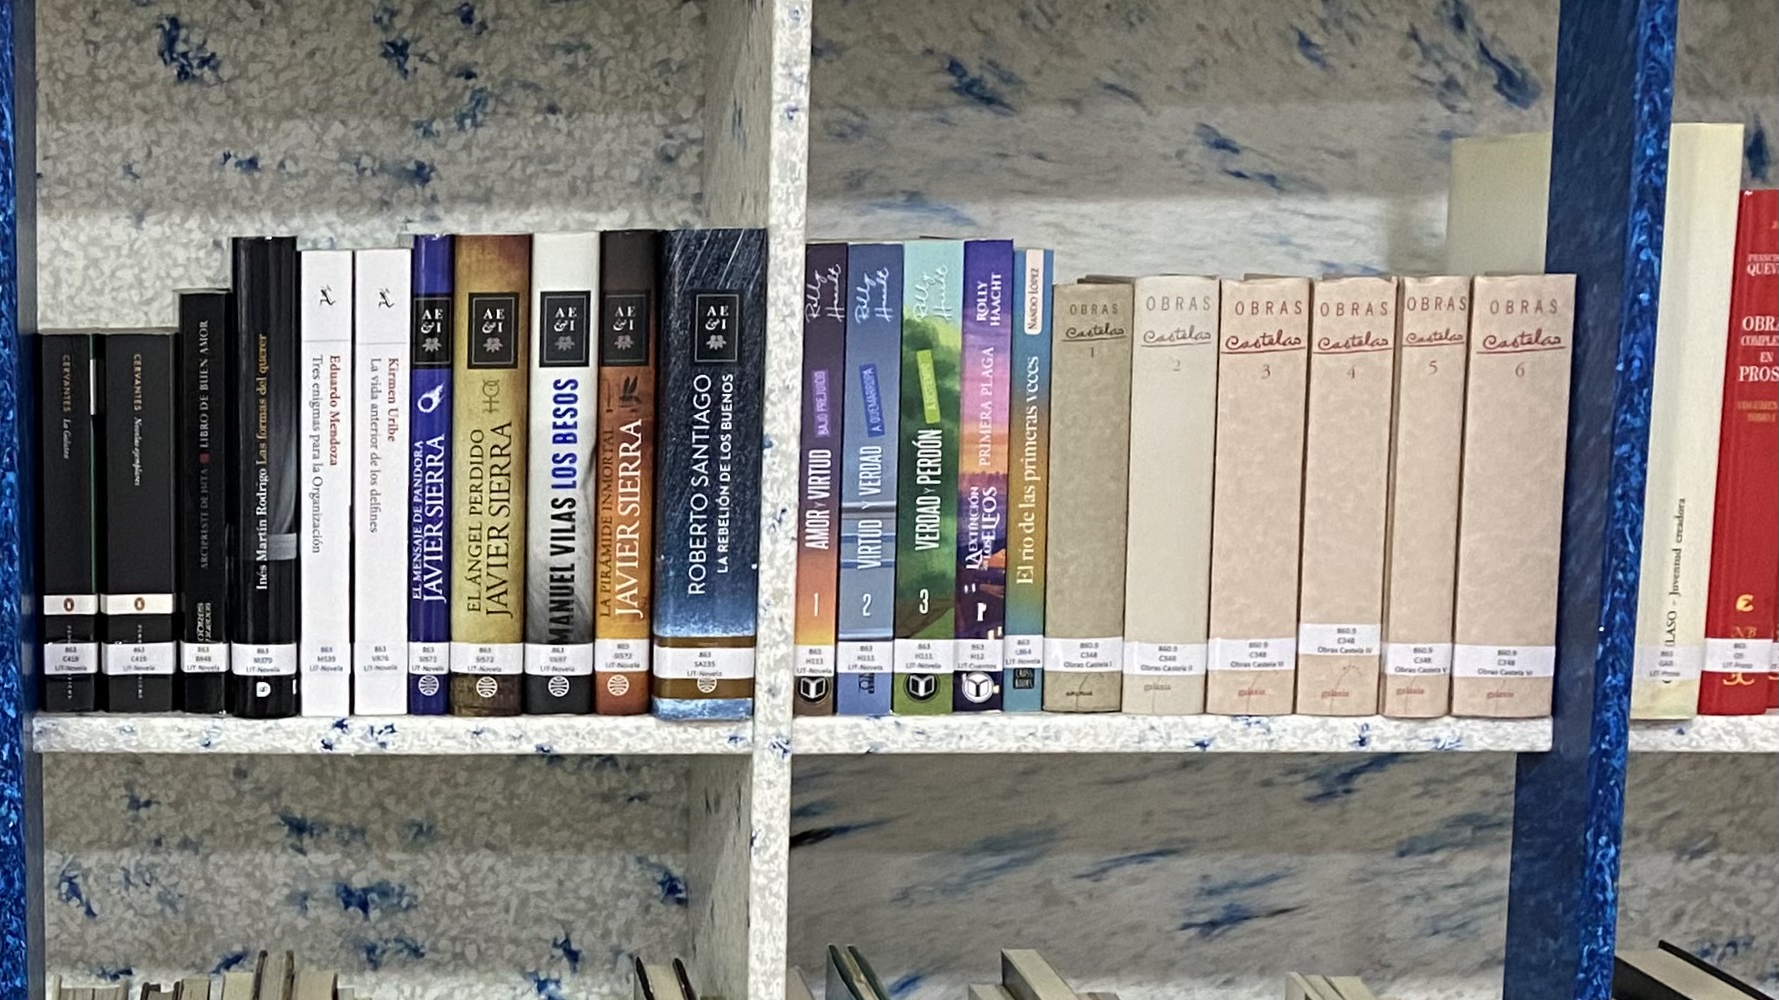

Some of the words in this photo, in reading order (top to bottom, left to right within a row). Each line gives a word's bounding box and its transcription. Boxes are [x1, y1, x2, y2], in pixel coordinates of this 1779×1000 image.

[976, 281, 990, 321] ROLLY
[987, 273, 1002, 326] HAACHT
[1069, 303, 1118, 315] OBRAS
[1235, 301, 1303, 316] OBRAS
[1490, 299, 1558, 315] OBRAS
[198, 321, 209, 354] AMOR
[257, 334, 270, 374] querer
[199, 358, 210, 393] BUEN
[256, 377, 268, 396] del
[328, 355, 341, 407] Eduardo
[980, 347, 994, 396] PLAGA
[199, 396, 210, 410] DE
[255, 400, 268, 439] formas
[552, 379, 578, 444] BESOS
[721, 374, 734, 430] BUENOS
[199, 413, 210, 448] LIBRO
[329, 411, 341, 465] Mendoza
[691, 374, 711, 487] SANTIAGO
[719, 434, 732, 459] LOS
[979, 401, 992, 466] PRIMERA
[256, 443, 268, 465] Las
[412, 441, 423, 503] PANDORA
[424, 434, 445, 518] SIERRA
[468, 429, 484, 516] PERDIDO
[489, 422, 512, 518] SIERRA
[551, 453, 577, 490] LOS
[719, 462, 731, 482] DE
[255, 468, 271, 515] Rodrigo
[412, 506, 423, 523] DE
[551, 497, 576, 556] VILAS
[715, 485, 731, 553] REBELIÓN
[255, 519, 269, 561] Martín
[412, 526, 423, 582] MENSAJE
[466, 522, 483, 587] ÁNGEL
[689, 493, 708, 595] ROBERTO
[255, 564, 269, 590] Inés
[423, 522, 447, 603] JAVIER
[486, 522, 514, 618] JAVIER
[717, 557, 729, 573] LA
[412, 585, 422, 599] EL
[468, 591, 482, 612] EL
[548, 563, 575, 640] MANUEL
